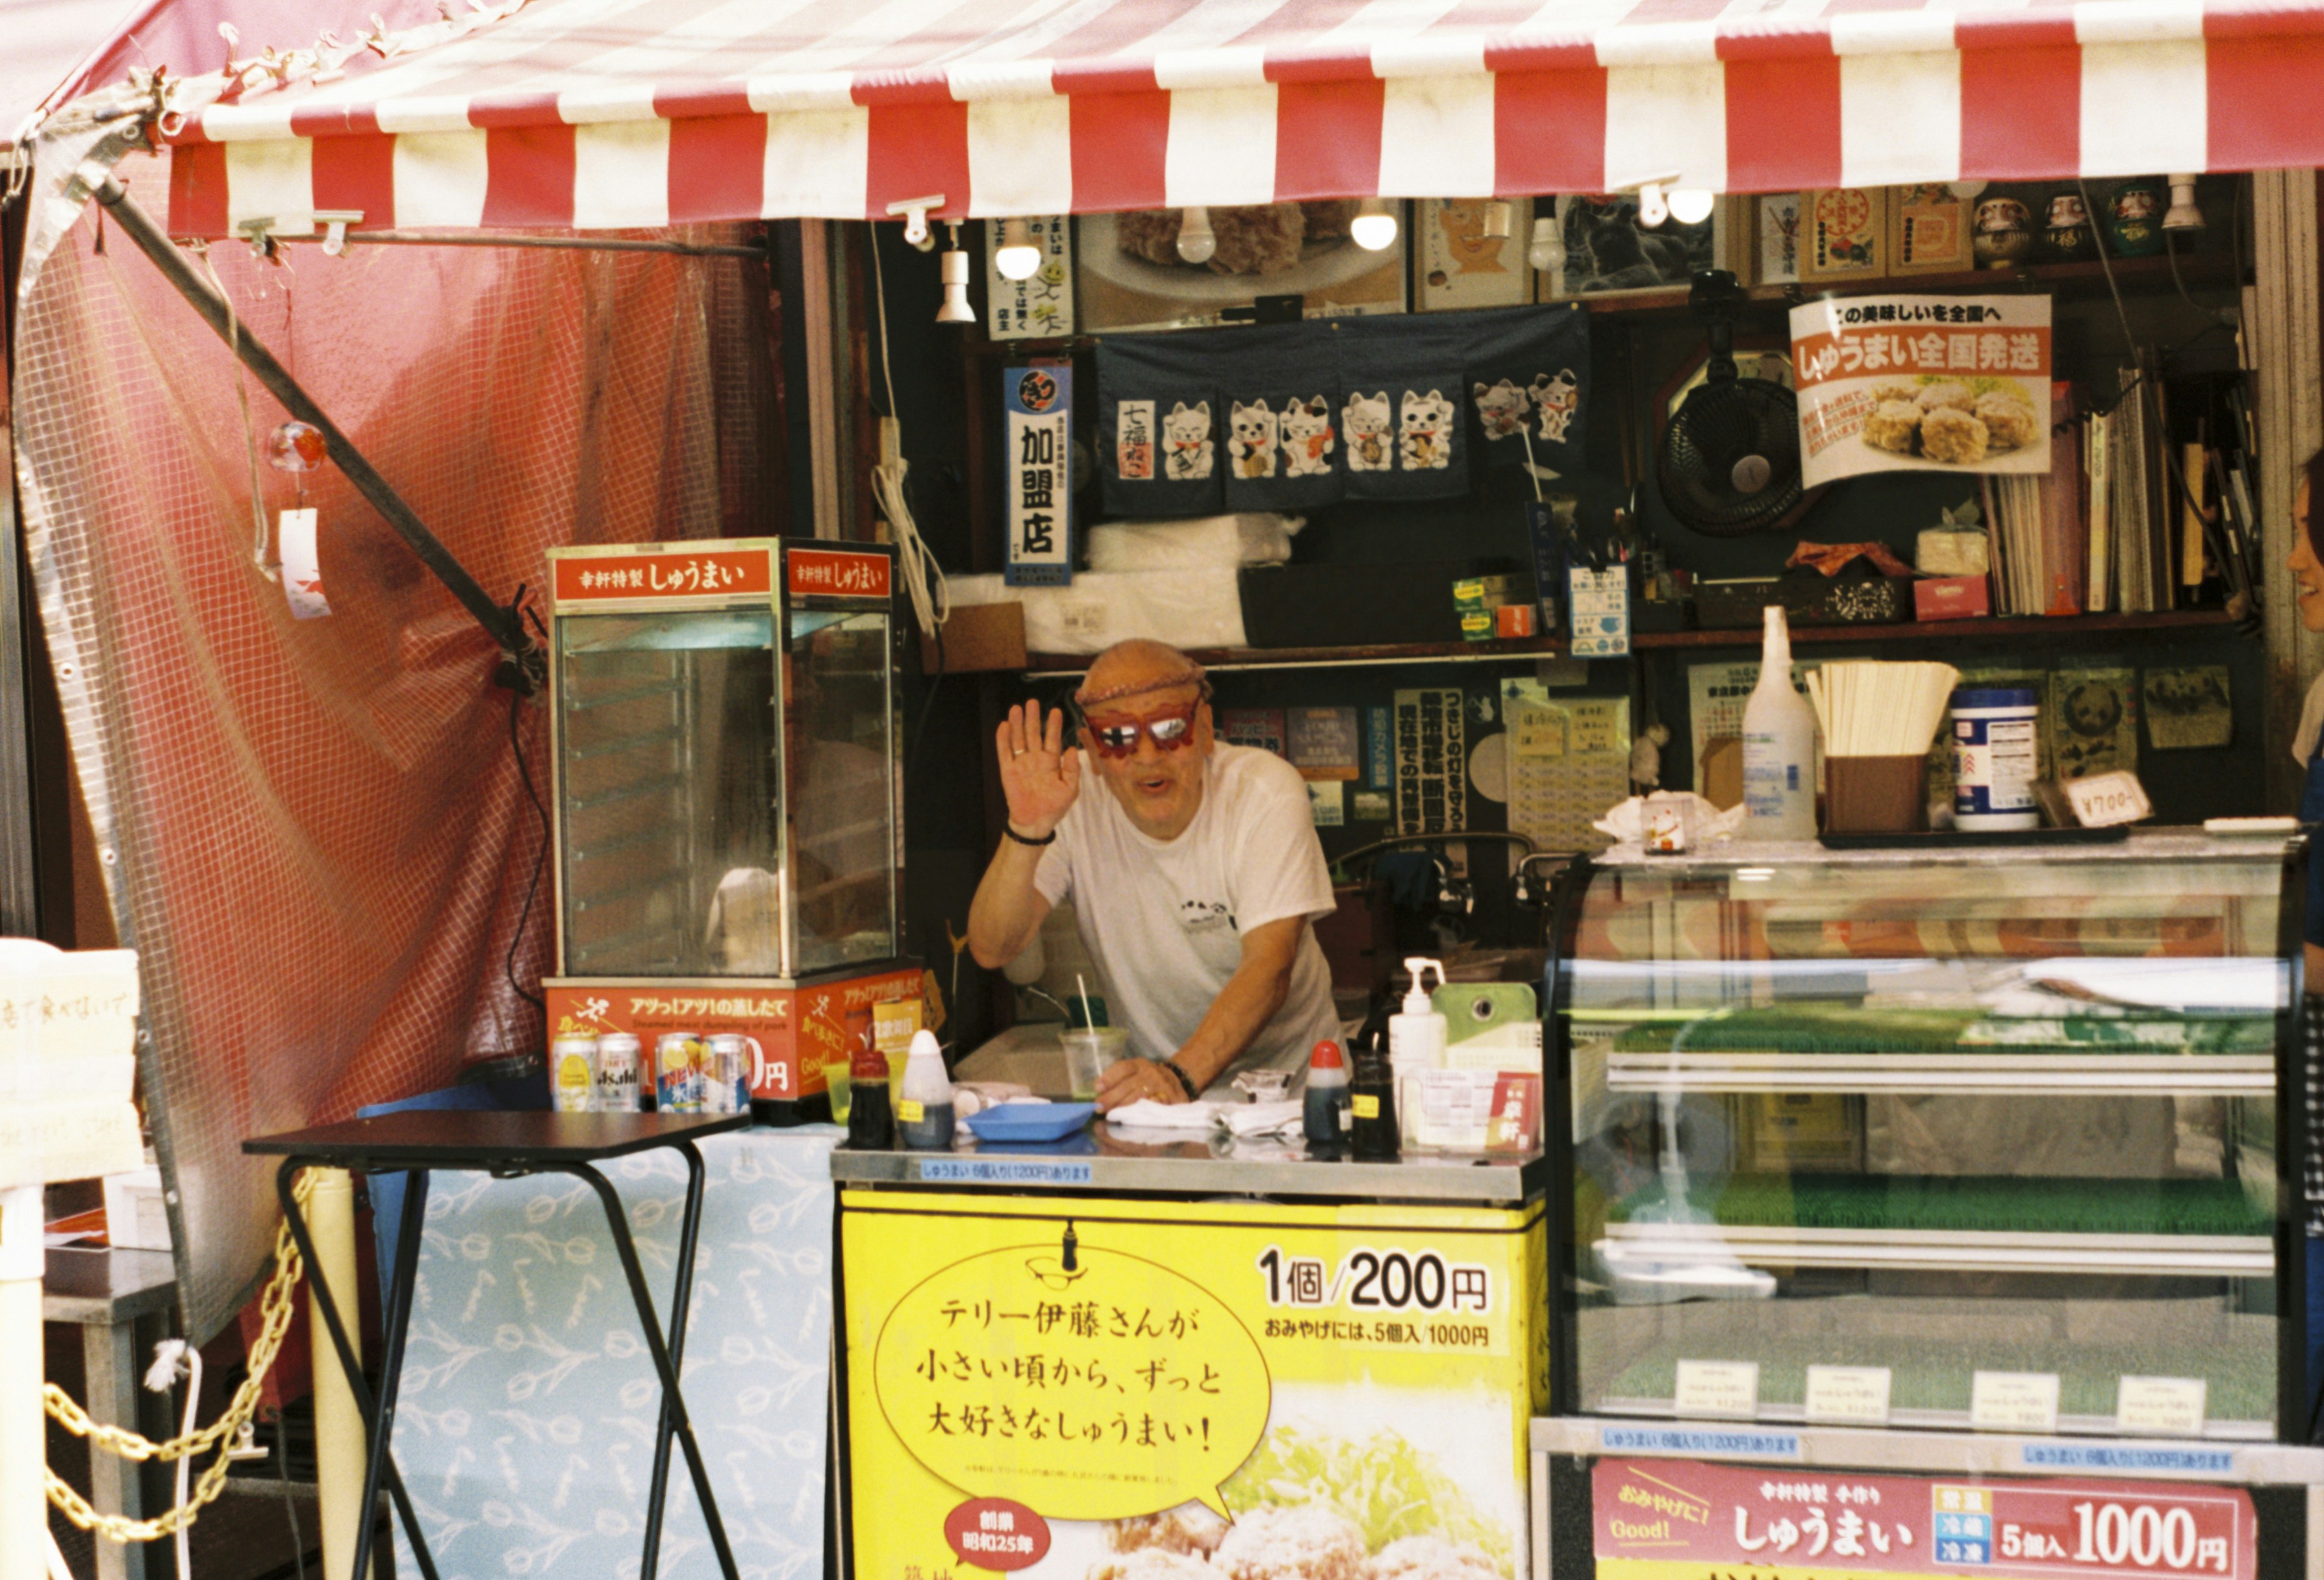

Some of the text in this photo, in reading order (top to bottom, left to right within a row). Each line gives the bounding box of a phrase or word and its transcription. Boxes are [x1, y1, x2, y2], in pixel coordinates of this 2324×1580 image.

[1799, 332, 2039, 381] しゅうまい全国発送
[1022, 425, 1054, 553] 加盟店
[579, 560, 744, 590] 幸軒特製 しゅうまい
[796, 561, 883, 590] 幸軒特製 しゅうまい
[597, 1068, 637, 1086] Asahi
[941, 1299, 1200, 1340] テリー伊藤さんが
[916, 1349, 1220, 1394] 小さい頃から、ずっと
[927, 1401, 1209, 1452] 大好きなしゅうまい!
[1619, 1485, 1710, 1525] おみやげに!
[1760, 1481, 1880, 1505] 幸軒特製 手作り
[980, 1510, 1014, 1533] 創業
[1610, 1519, 1669, 1539] Good!
[1736, 1506, 1912, 1556] しゅうまい
[963, 1532, 1033, 1554] 昭和25年
